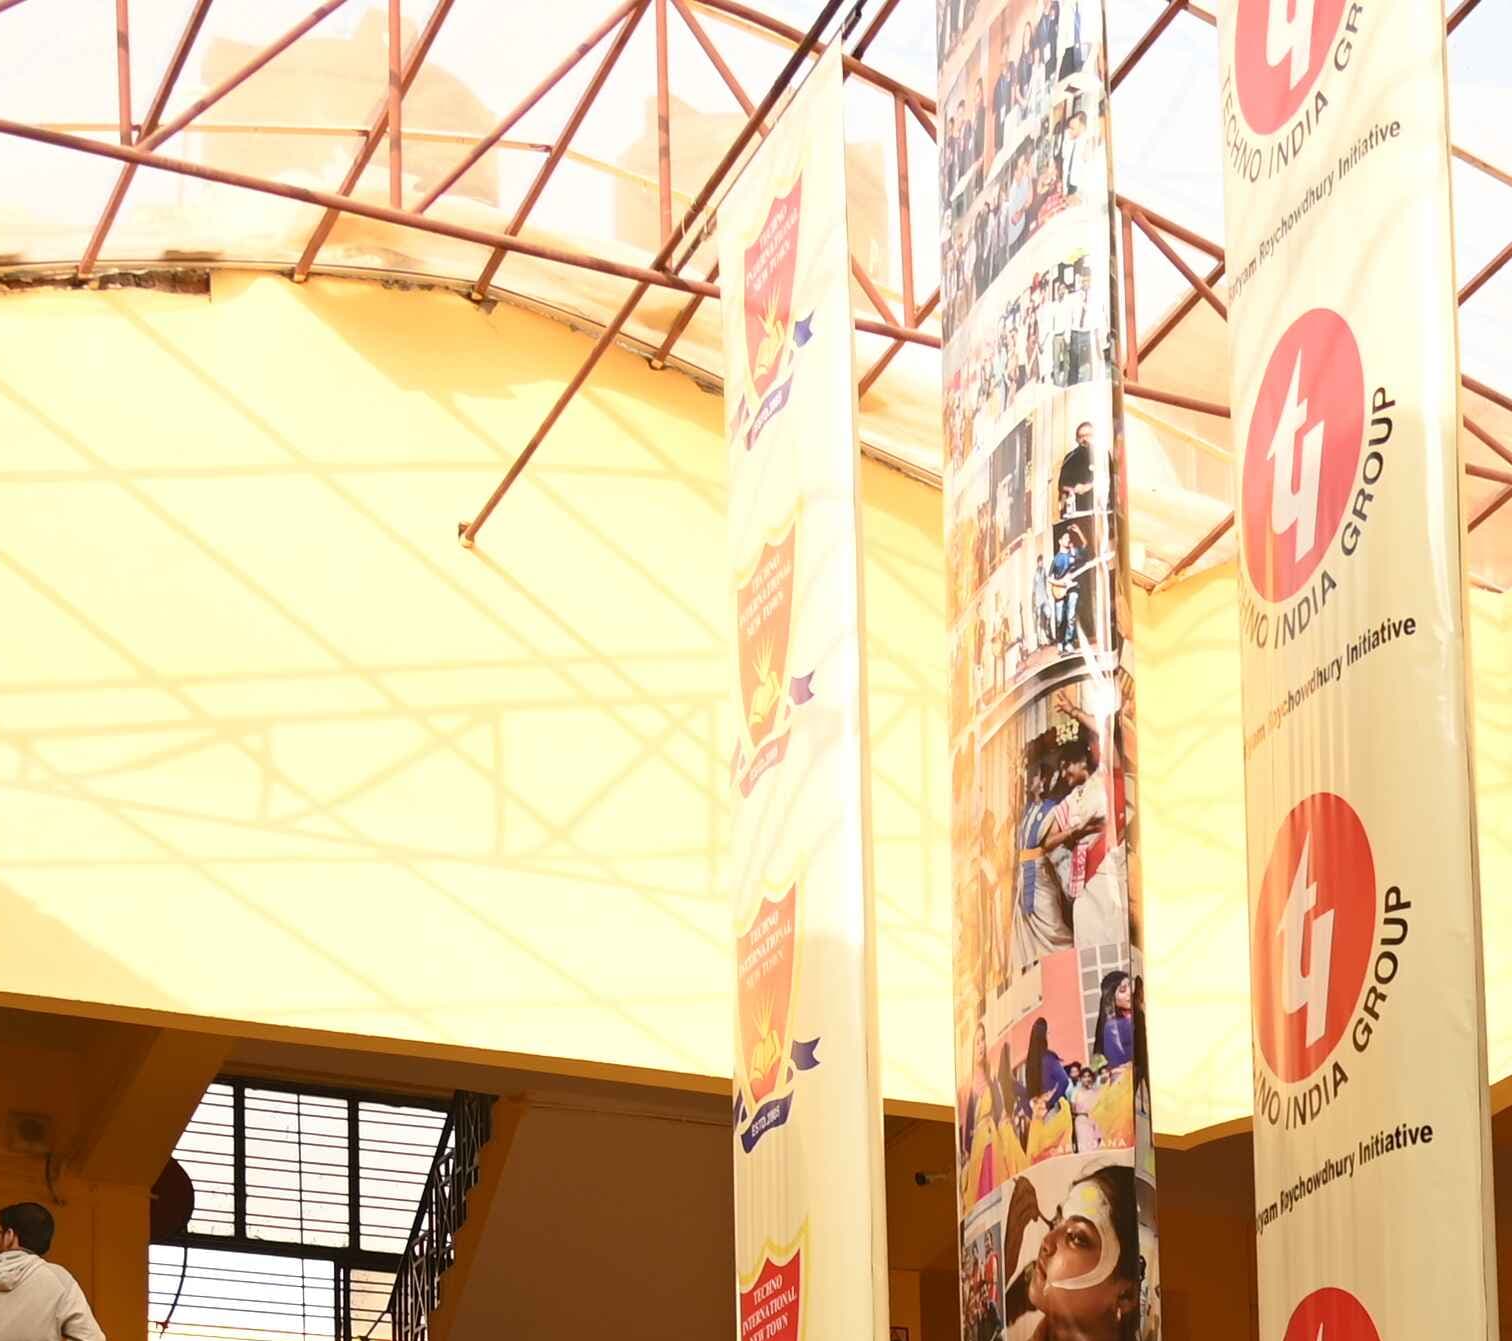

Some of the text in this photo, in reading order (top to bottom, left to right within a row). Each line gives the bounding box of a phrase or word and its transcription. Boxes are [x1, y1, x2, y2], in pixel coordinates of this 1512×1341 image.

[1268, 90, 1329, 179] INDIA
[1259, 171, 1335, 267] Roychowdhury
[1338, 120, 1401, 180] Initiative
[1274, 570, 1338, 650] INDIA
[1340, 386, 1396, 556] GROUP
[1346, 615, 1416, 667] Initiative
[1285, 885, 1412, 1131] INDIA GROUP
[1359, 1121, 1433, 1166] Initiative
[742, 1285, 797, 1337] INTERNATIONAL
[753, 1273, 783, 1306] TECHNO
[766, 1312, 789, 1341] TOWN
